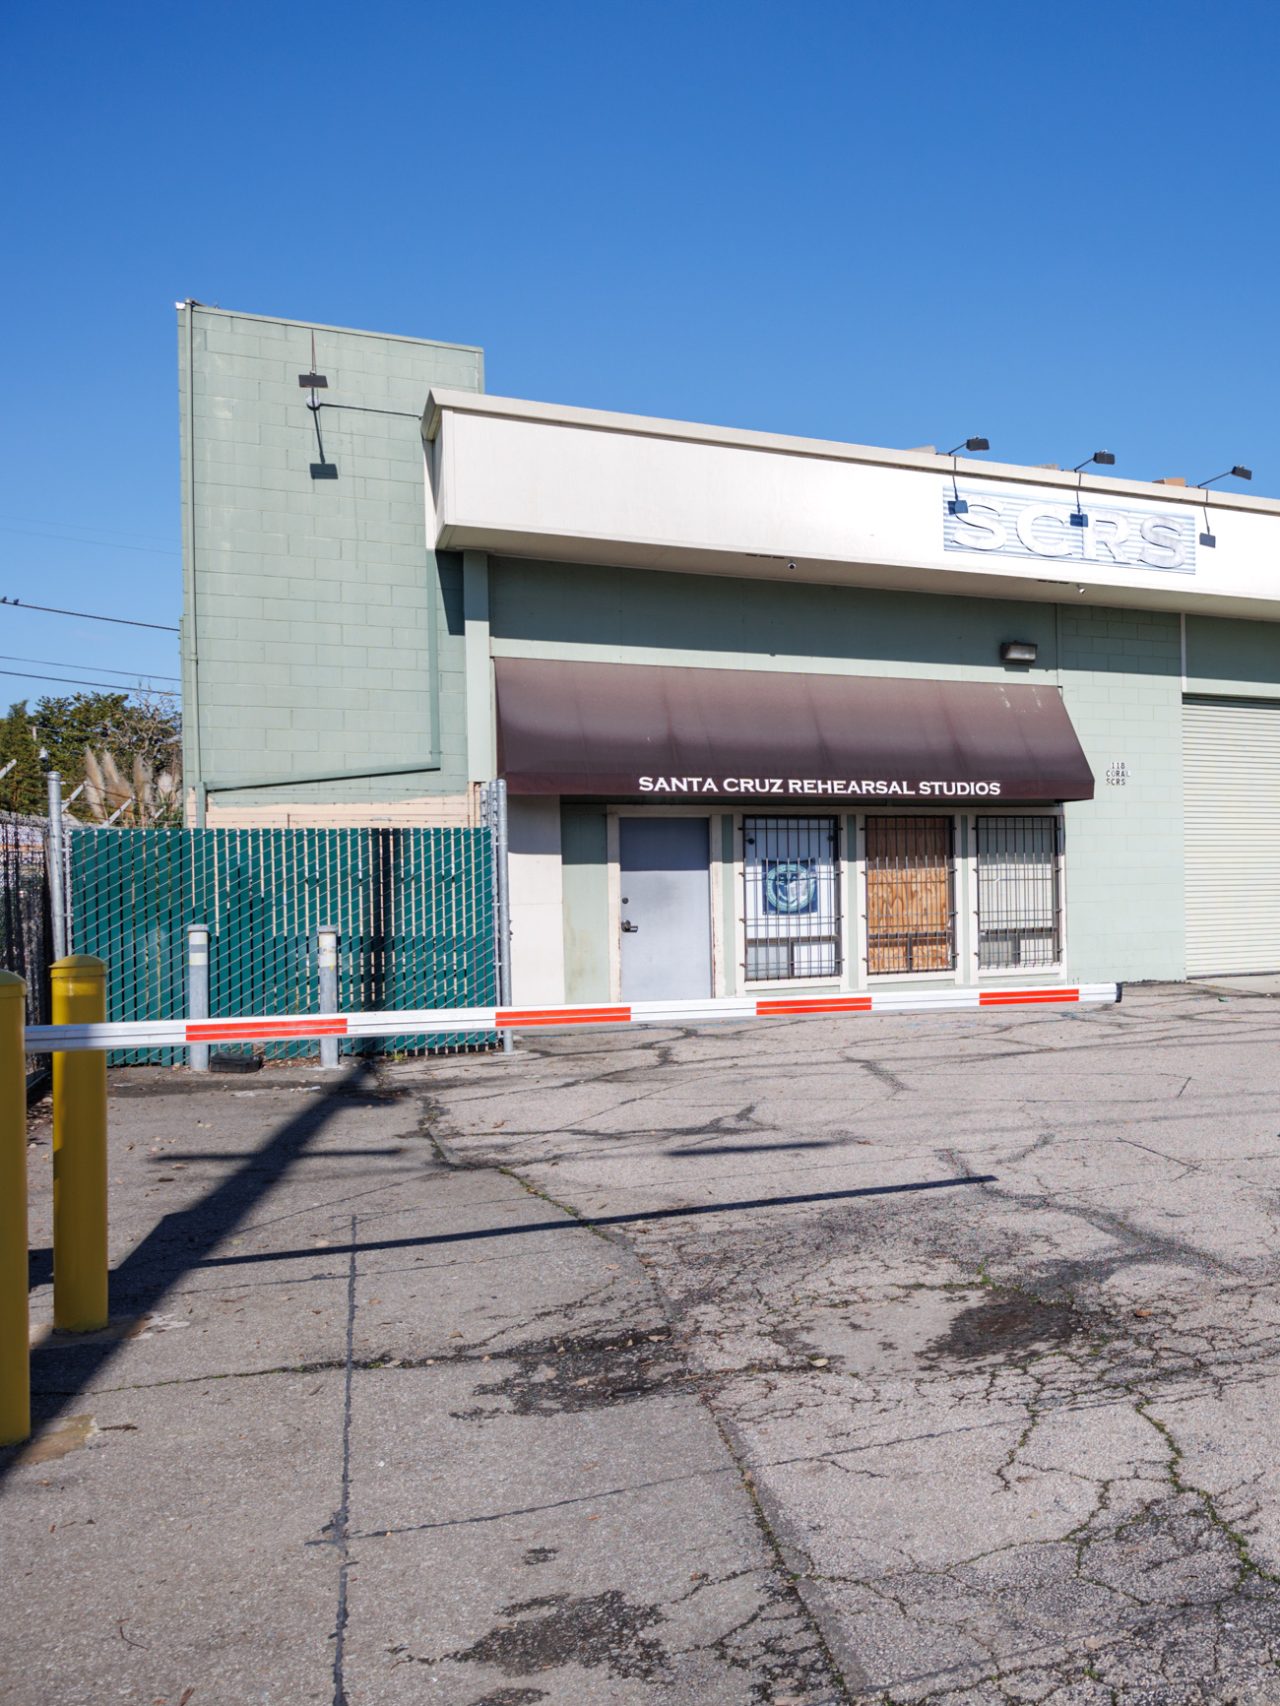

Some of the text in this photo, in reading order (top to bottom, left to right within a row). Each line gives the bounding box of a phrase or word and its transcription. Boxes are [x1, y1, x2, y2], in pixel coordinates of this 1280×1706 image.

[950, 494, 1187, 569] SCRS
[638, 776, 1001, 796] SANTA CRUZ REHEARSAL STUDIOS
